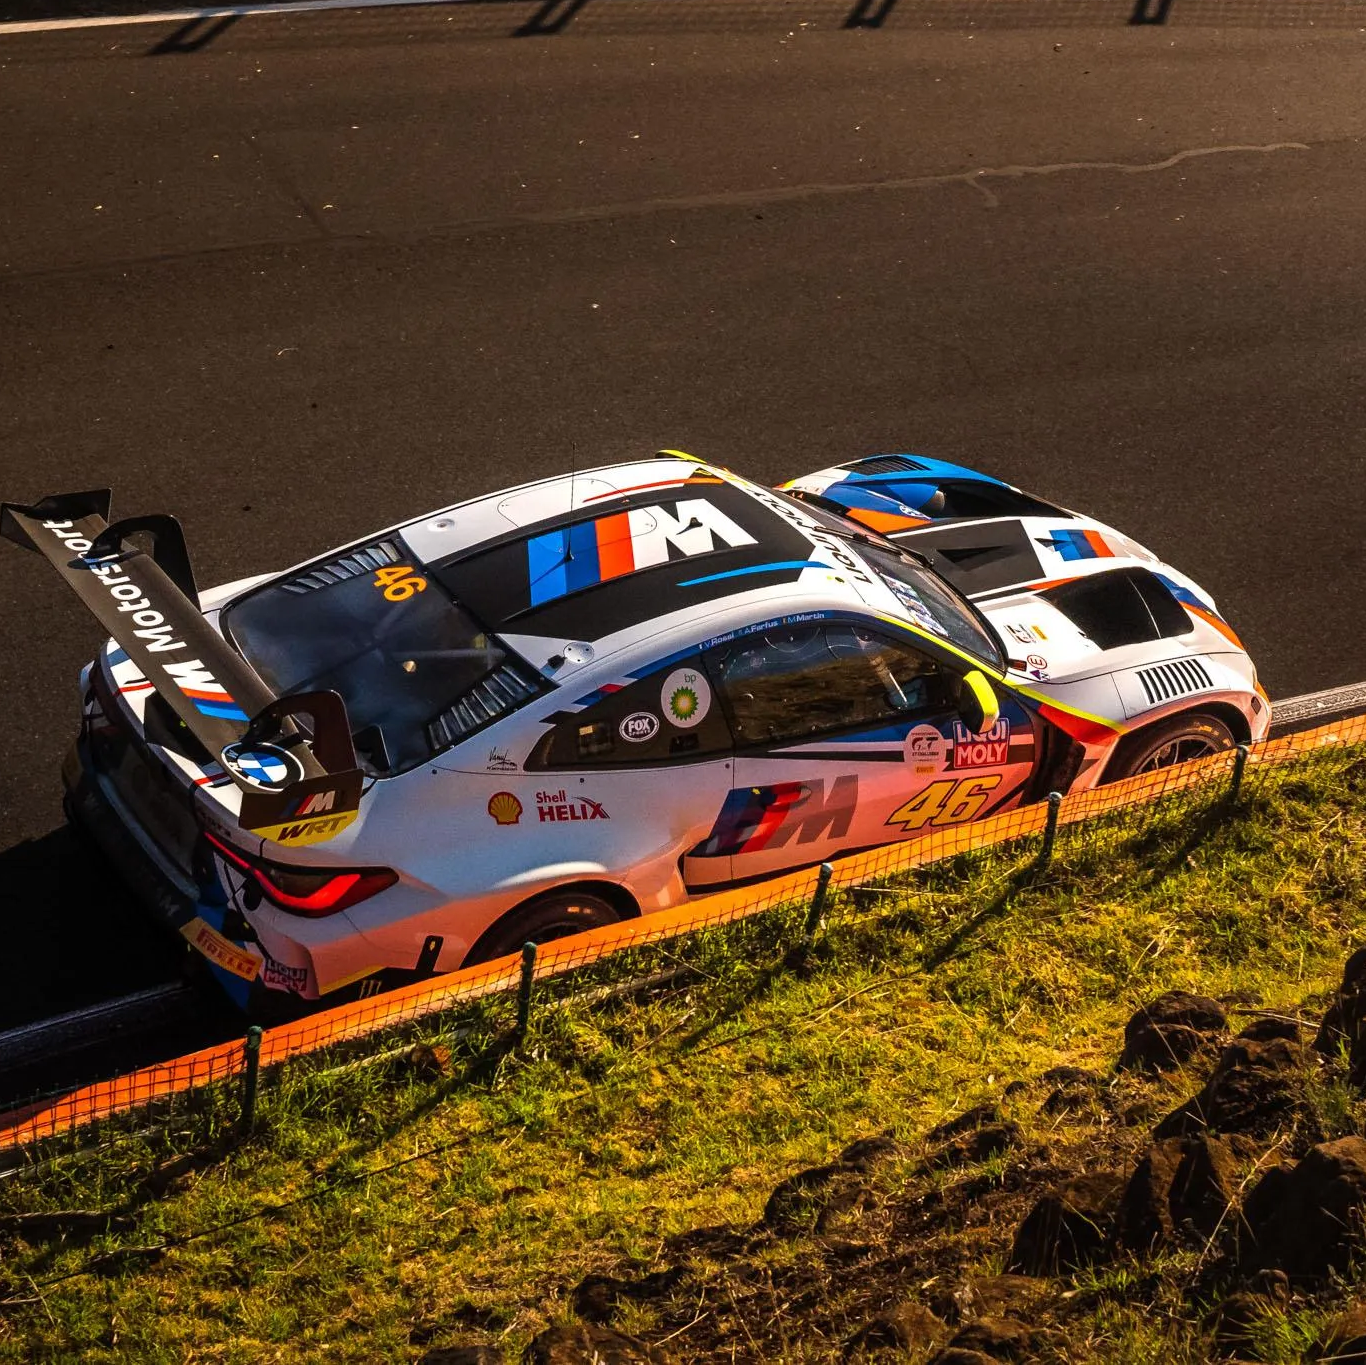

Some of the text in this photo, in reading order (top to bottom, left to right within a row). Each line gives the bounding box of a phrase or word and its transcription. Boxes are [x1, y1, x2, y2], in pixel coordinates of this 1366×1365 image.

[628, 498, 760, 572] M
[373, 565, 428, 602] 46
[162, 659, 229, 694] M
[684, 674, 697, 683] bp
[628, 718, 651, 733] FOX
[957, 742, 1007, 766] MOLY
[301, 790, 336, 815] M
[536, 790, 566, 804] Shell
[883, 773, 1004, 832] 46
[538, 801, 611, 823] HELIX
[761, 774, 859, 849] M
[277, 815, 348, 842] WRT
